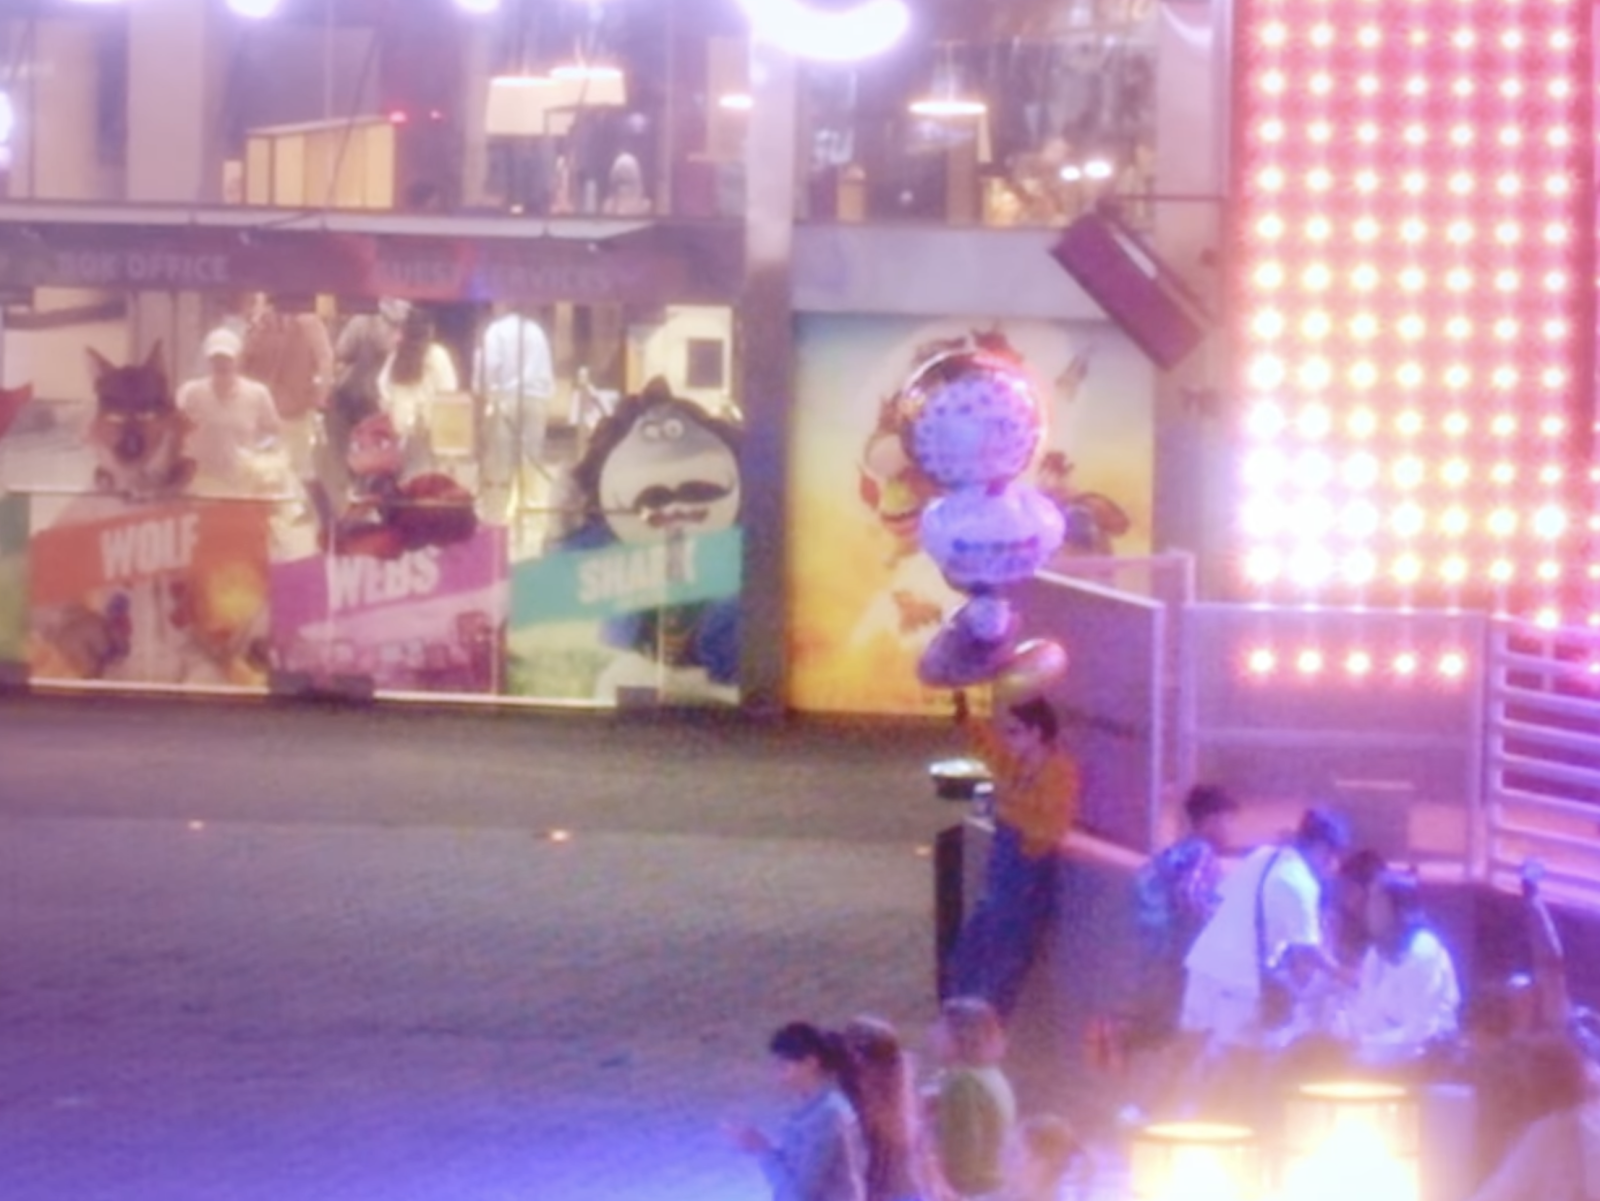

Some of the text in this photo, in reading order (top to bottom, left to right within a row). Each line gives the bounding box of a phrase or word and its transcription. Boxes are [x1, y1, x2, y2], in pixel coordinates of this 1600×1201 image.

[126, 252, 230, 282] OFFICE
[100, 512, 199, 581] WOLF
[326, 546, 440, 610] WEBS
